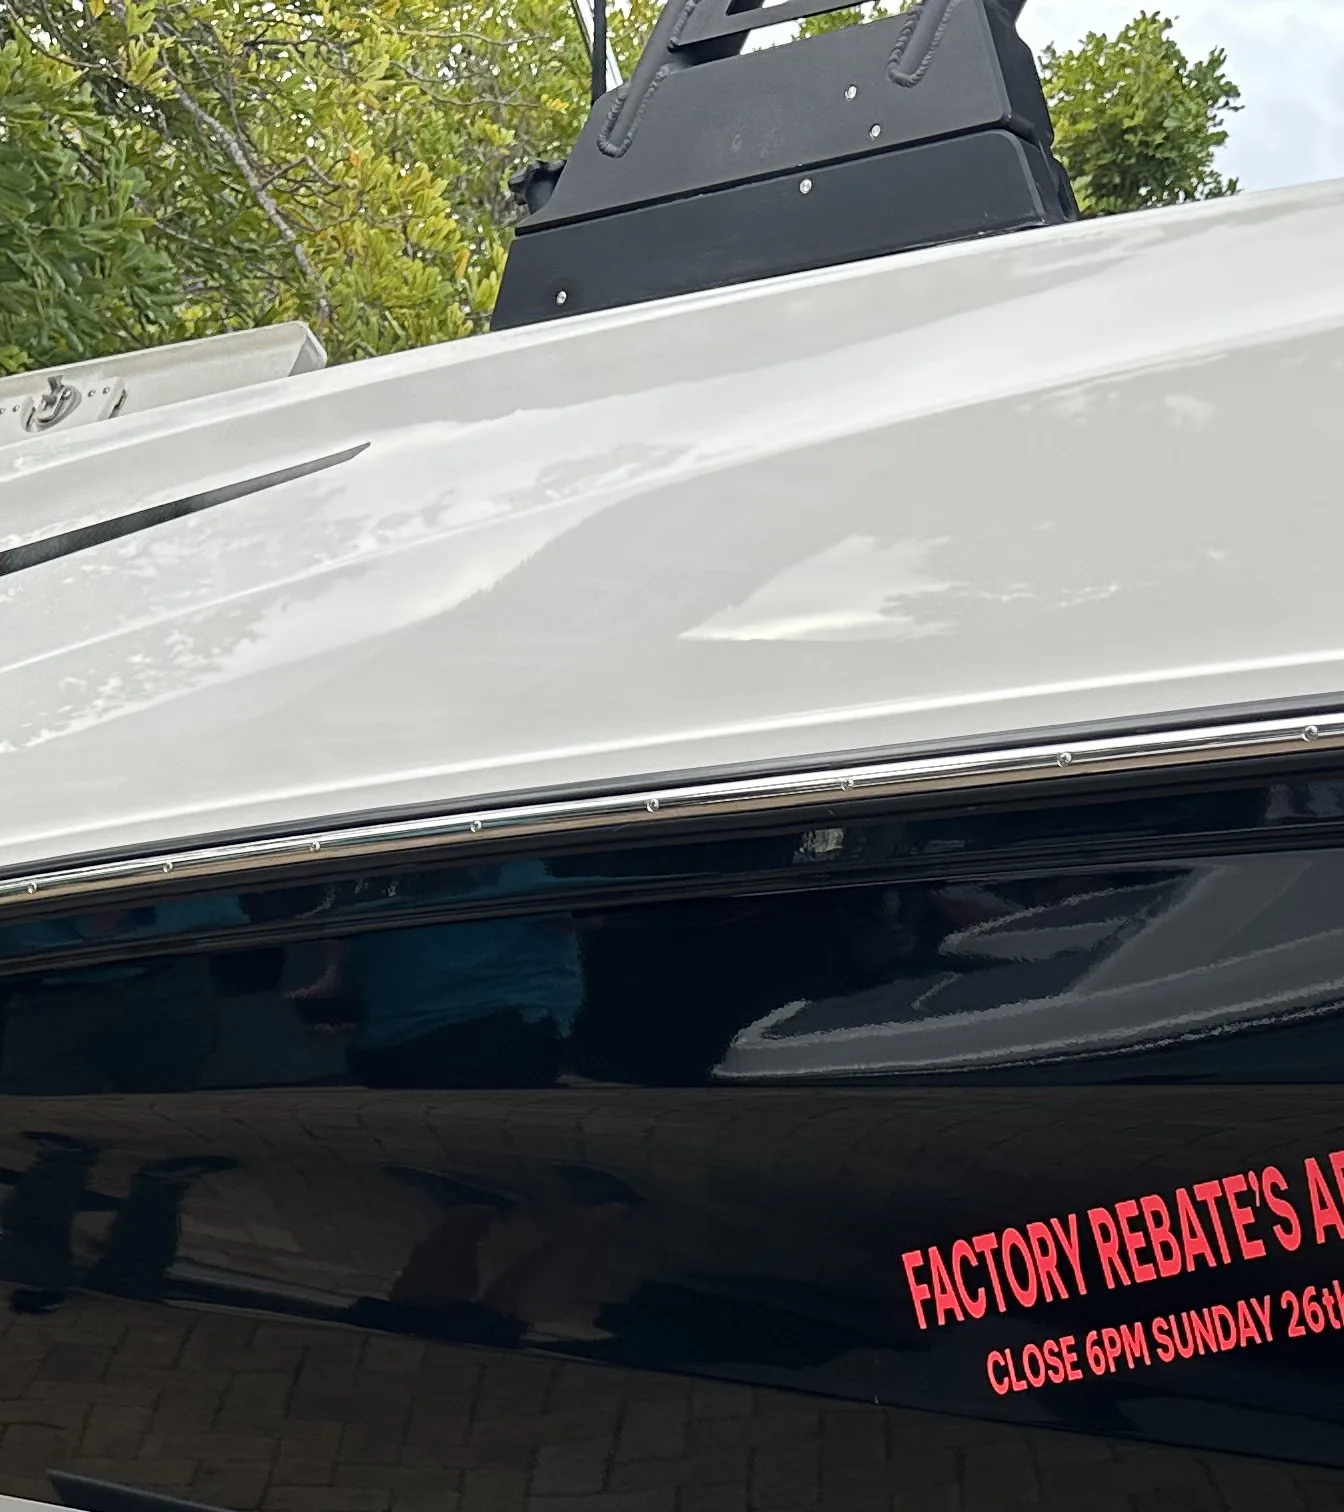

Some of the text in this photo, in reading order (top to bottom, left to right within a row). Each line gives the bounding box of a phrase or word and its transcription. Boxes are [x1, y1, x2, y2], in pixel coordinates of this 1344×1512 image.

[902, 1214, 1087, 1330] FACTORY
[1087, 1166, 1303, 1289] REBATE'S
[986, 1335, 1083, 1395] CLOSE
[1086, 1321, 1152, 1377] 6PM
[1152, 1294, 1274, 1363] SUNDAY
